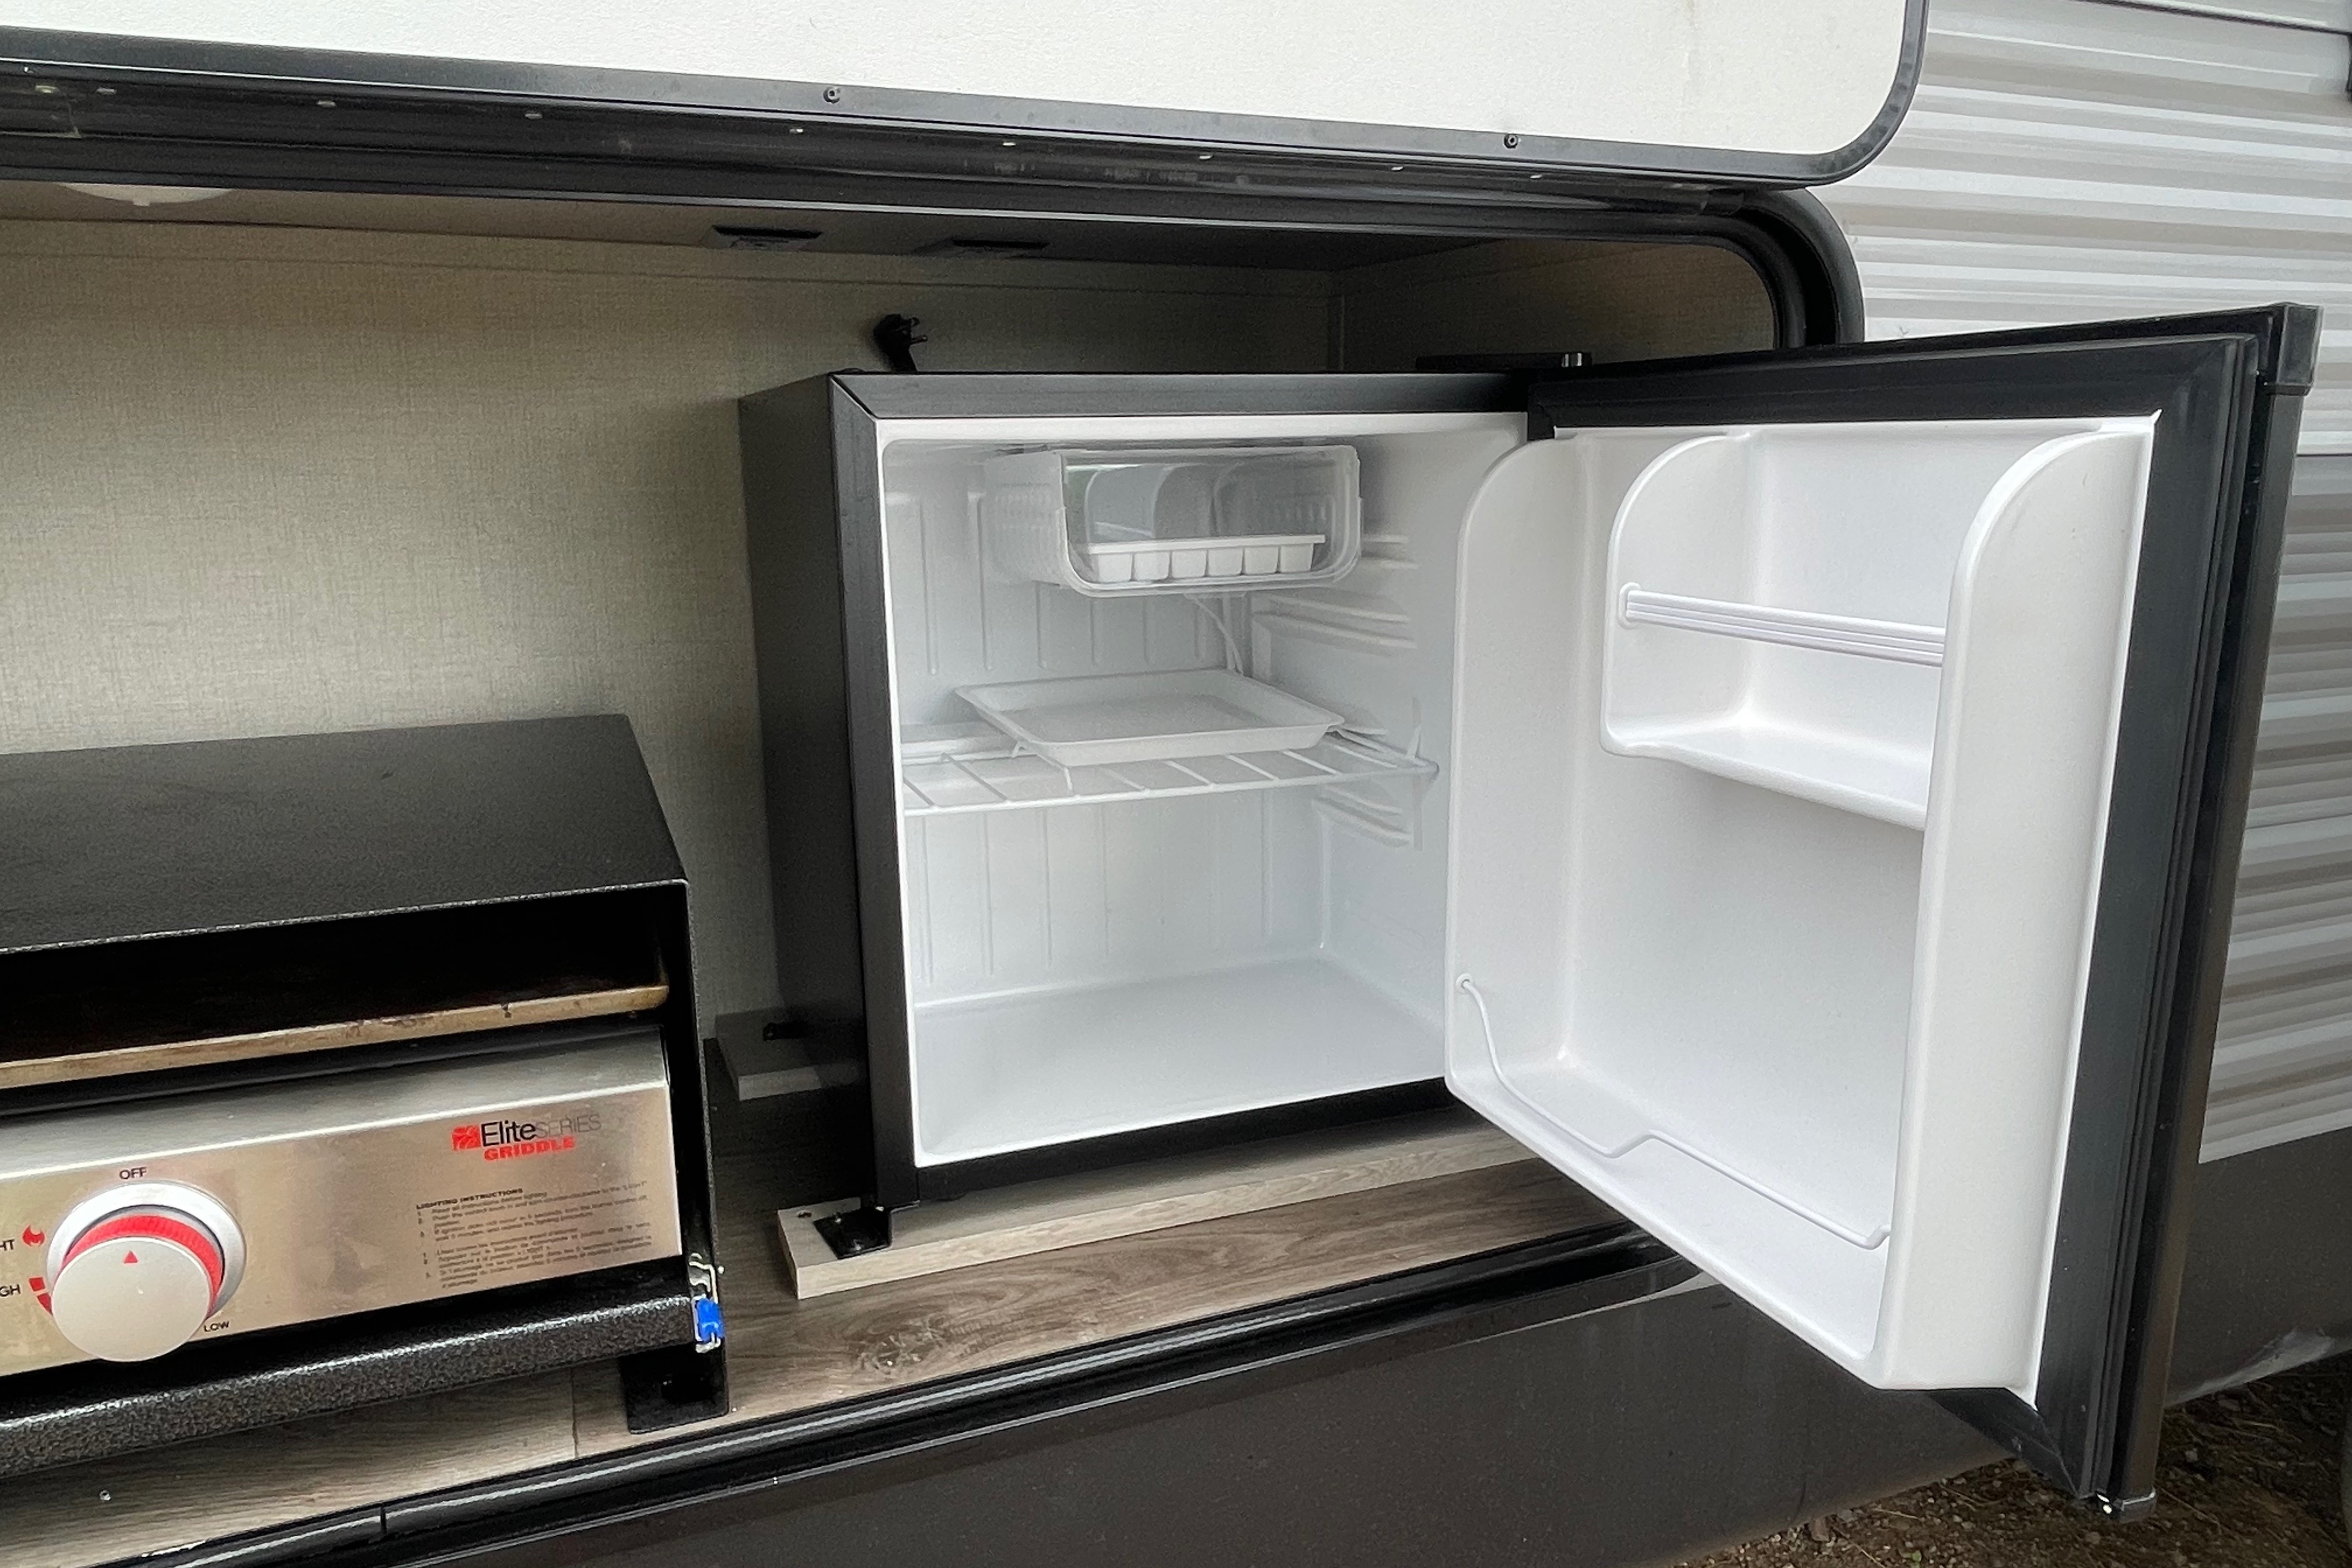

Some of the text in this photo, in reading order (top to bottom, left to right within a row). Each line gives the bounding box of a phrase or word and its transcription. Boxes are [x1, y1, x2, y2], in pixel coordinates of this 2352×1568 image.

[484, 1135, 575, 1160] GRIDDLE
[119, 1167, 146, 1179] OFF
[204, 1321, 229, 1332] LOW
